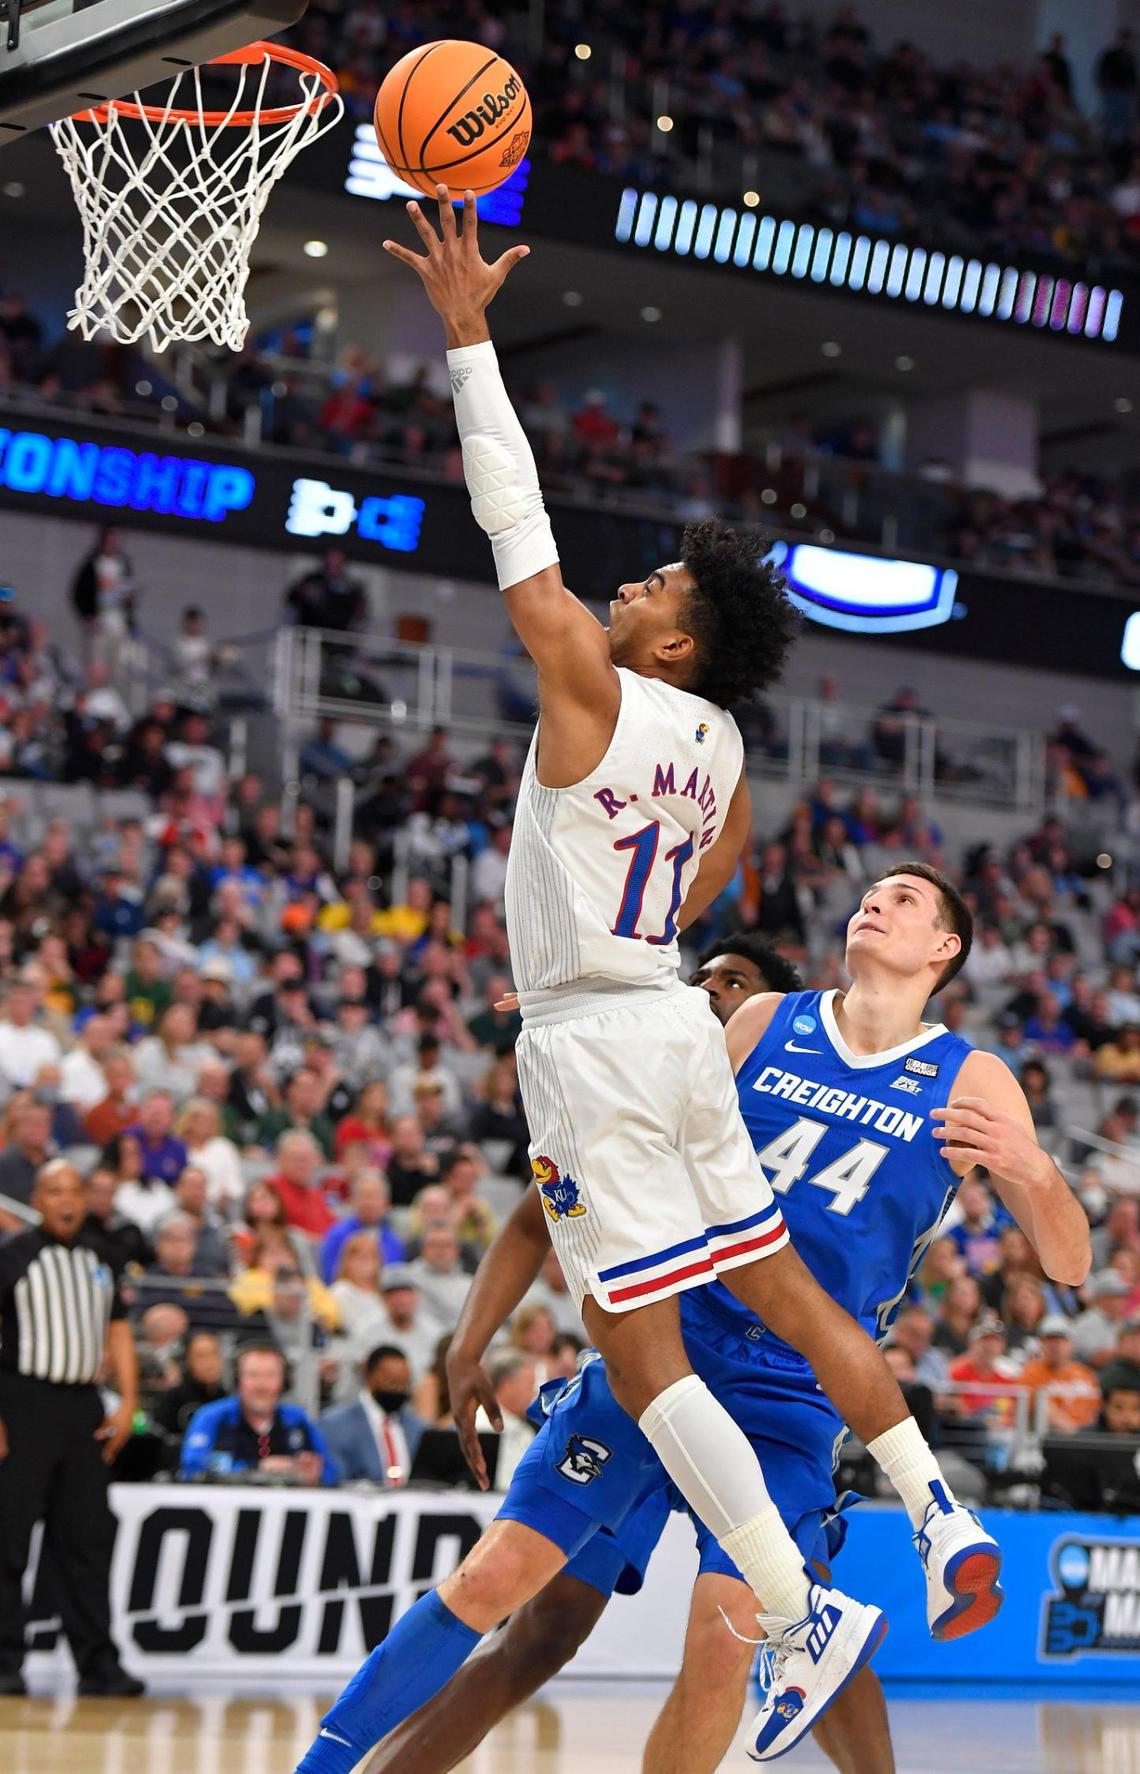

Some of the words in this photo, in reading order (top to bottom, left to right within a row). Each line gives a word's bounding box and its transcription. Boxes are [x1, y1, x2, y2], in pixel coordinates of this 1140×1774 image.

[446, 73, 522, 147] Wilson
[593, 787, 640, 821] R.
[651, 761, 718, 850] MARTIN
[609, 819, 694, 946] 11
[752, 1066, 925, 1143] CREIGHTON
[757, 1116, 891, 1217] 44
